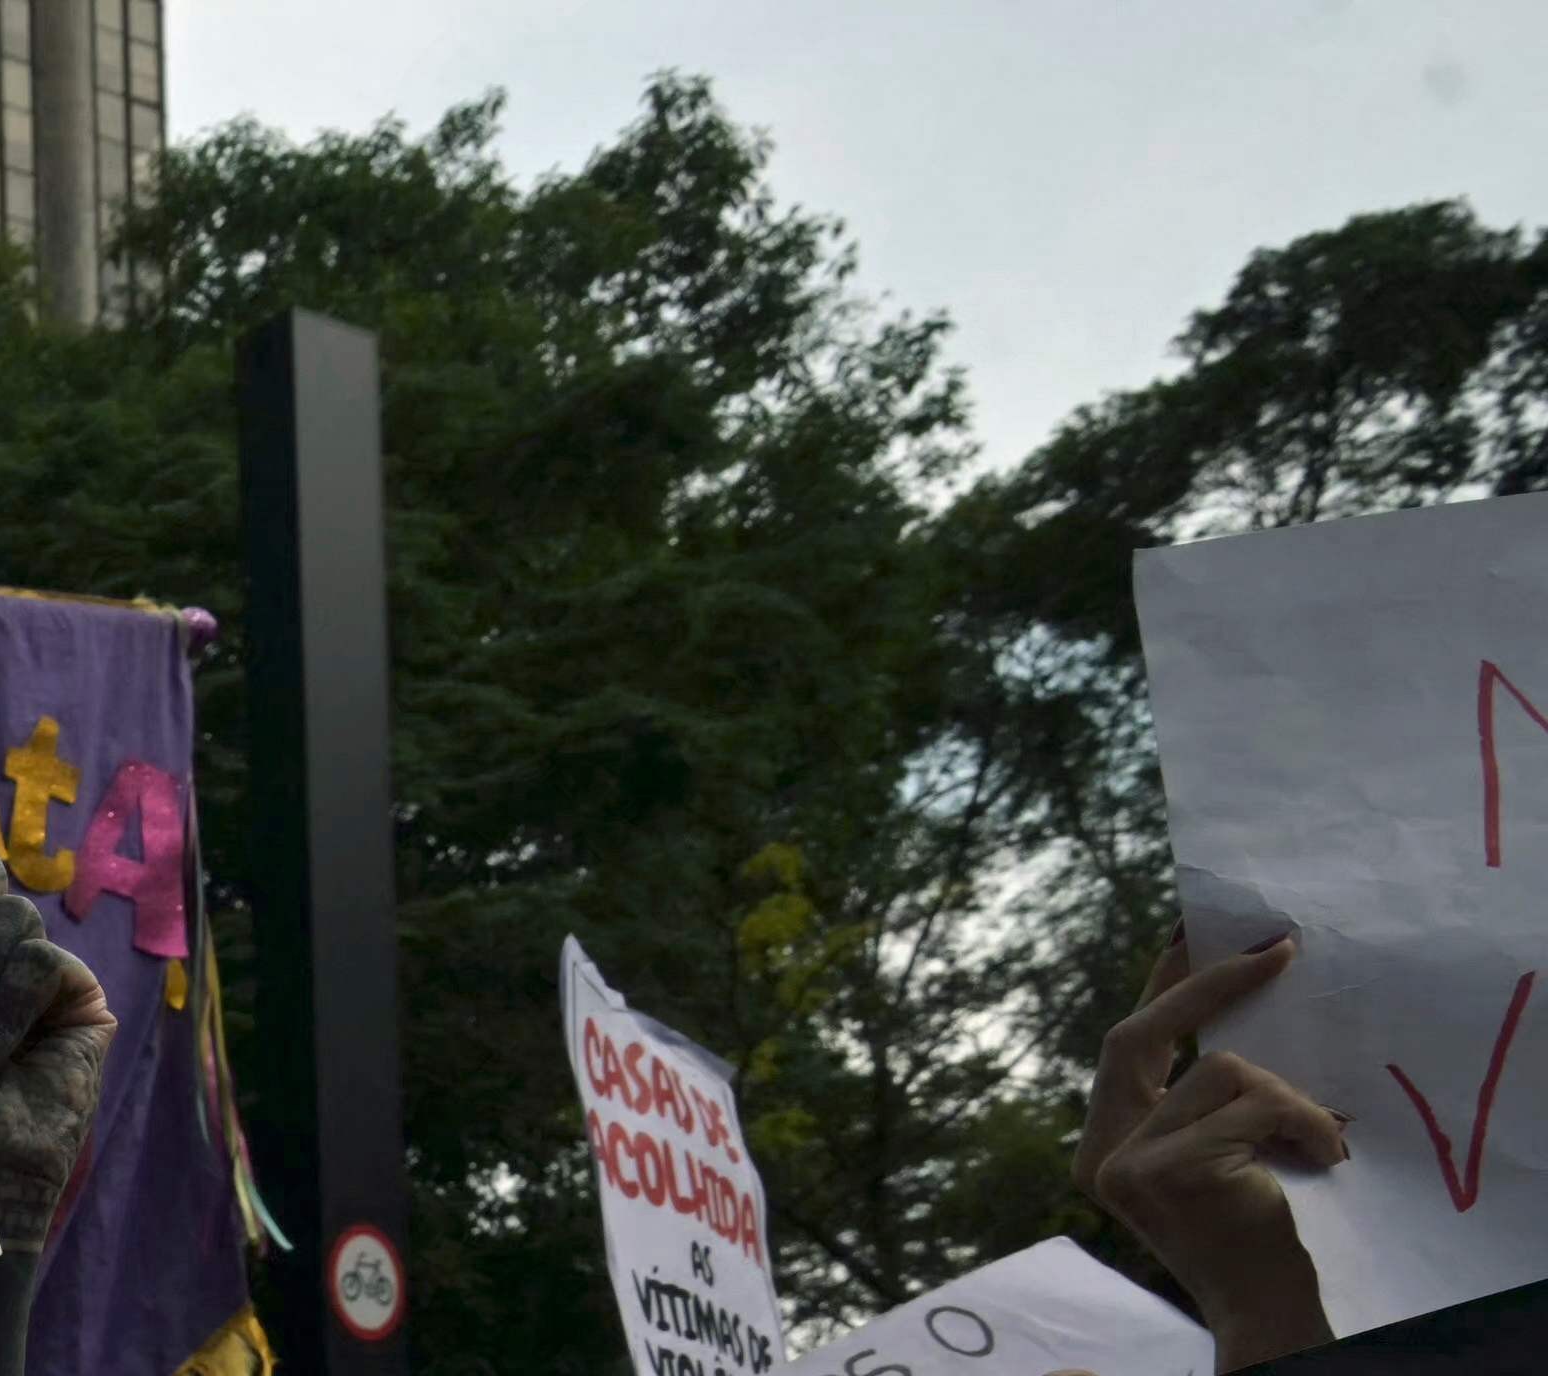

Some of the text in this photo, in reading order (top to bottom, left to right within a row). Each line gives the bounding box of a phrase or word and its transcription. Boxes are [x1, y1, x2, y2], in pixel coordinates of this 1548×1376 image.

[585, 1017, 694, 1134] CASAS
[587, 1109, 764, 1268] ACOLHIDA
[691, 1241, 715, 1286] AS
[632, 1266, 744, 1367] VÍTIMAS
[924, 1305, 995, 1357] O
